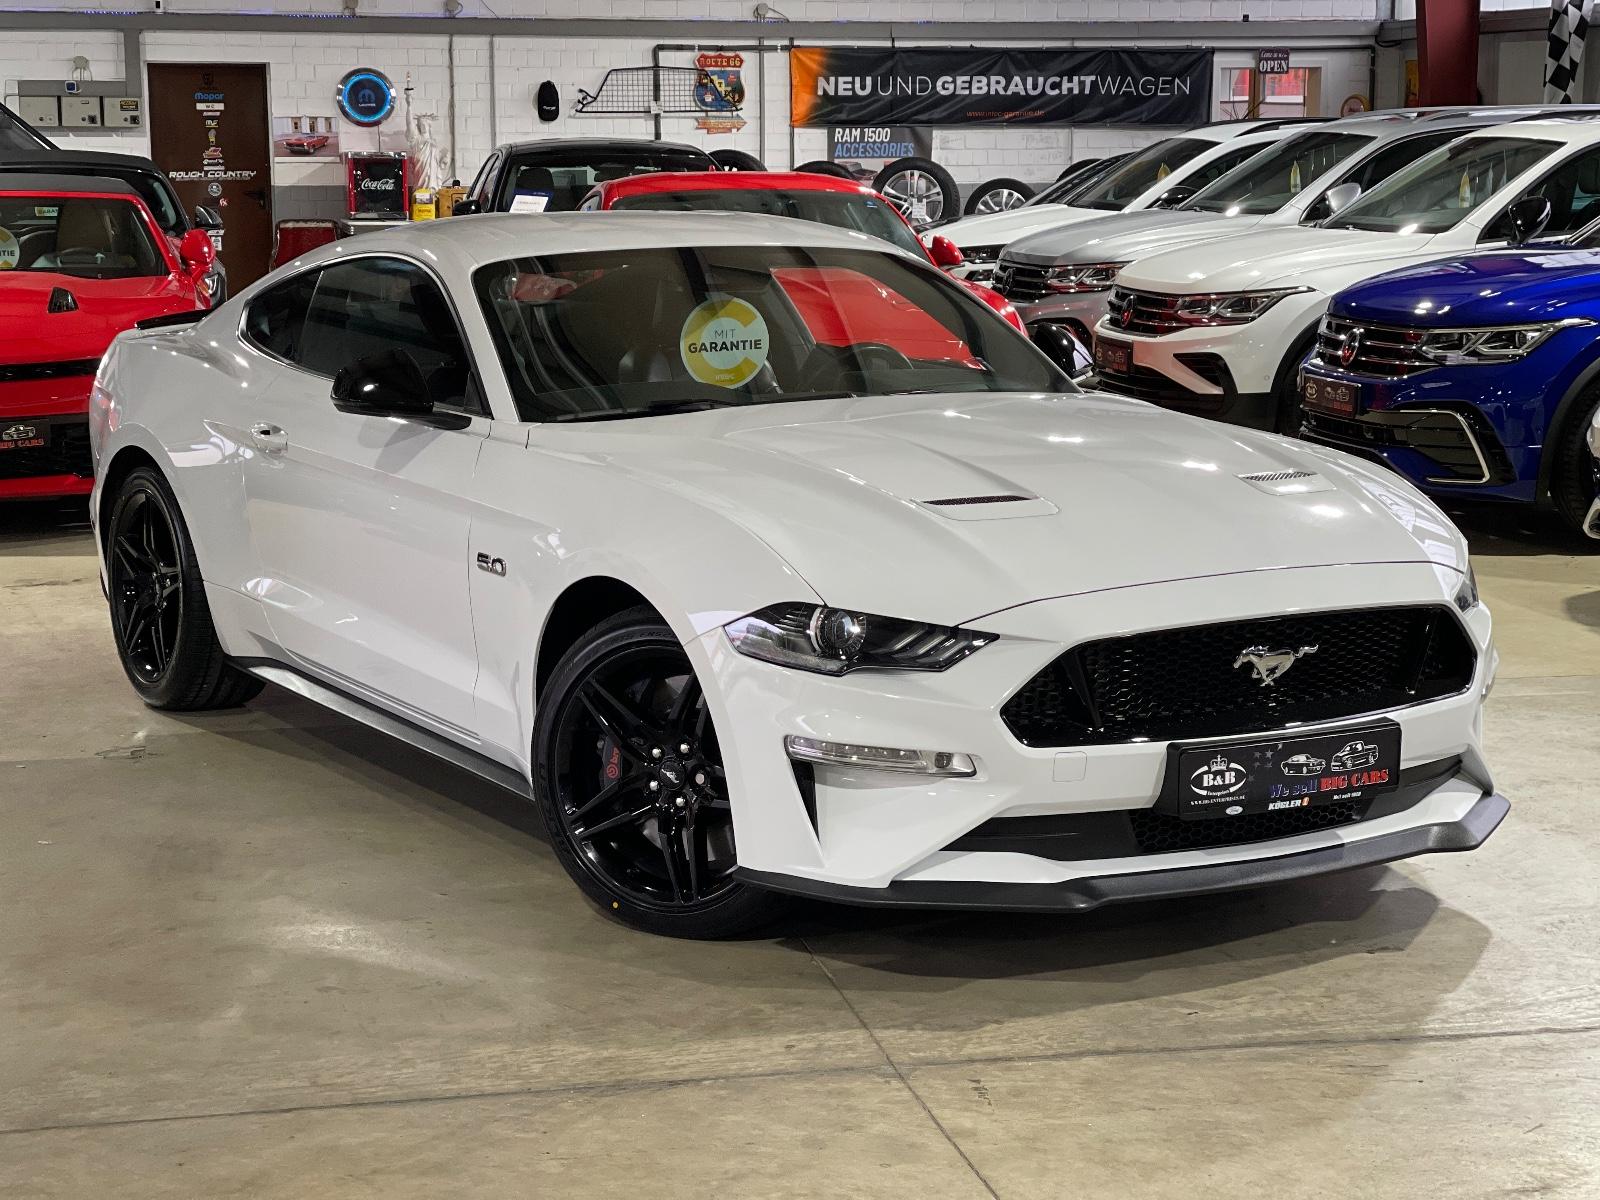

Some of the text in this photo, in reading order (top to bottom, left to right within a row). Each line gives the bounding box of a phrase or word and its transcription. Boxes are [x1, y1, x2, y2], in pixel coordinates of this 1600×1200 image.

[699, 57, 741, 66] ROUTE 66
[1259, 60, 1288, 72] OPEN
[816, 76, 872, 96] NEU
[877, 76, 932, 96] UND
[834, 127, 891, 142] RAM 1500
[834, 142, 914, 157] ACCESSORIES
[207, 170, 256, 178] COUNTRY
[714, 328, 736, 339] MIT
[688, 339, 762, 354] GARANTIE
[1202, 771, 1236, 787] B&B
[1269, 769, 1389, 798] We sell BIG CARS
[1268, 799, 1302, 811] KÖGLER
